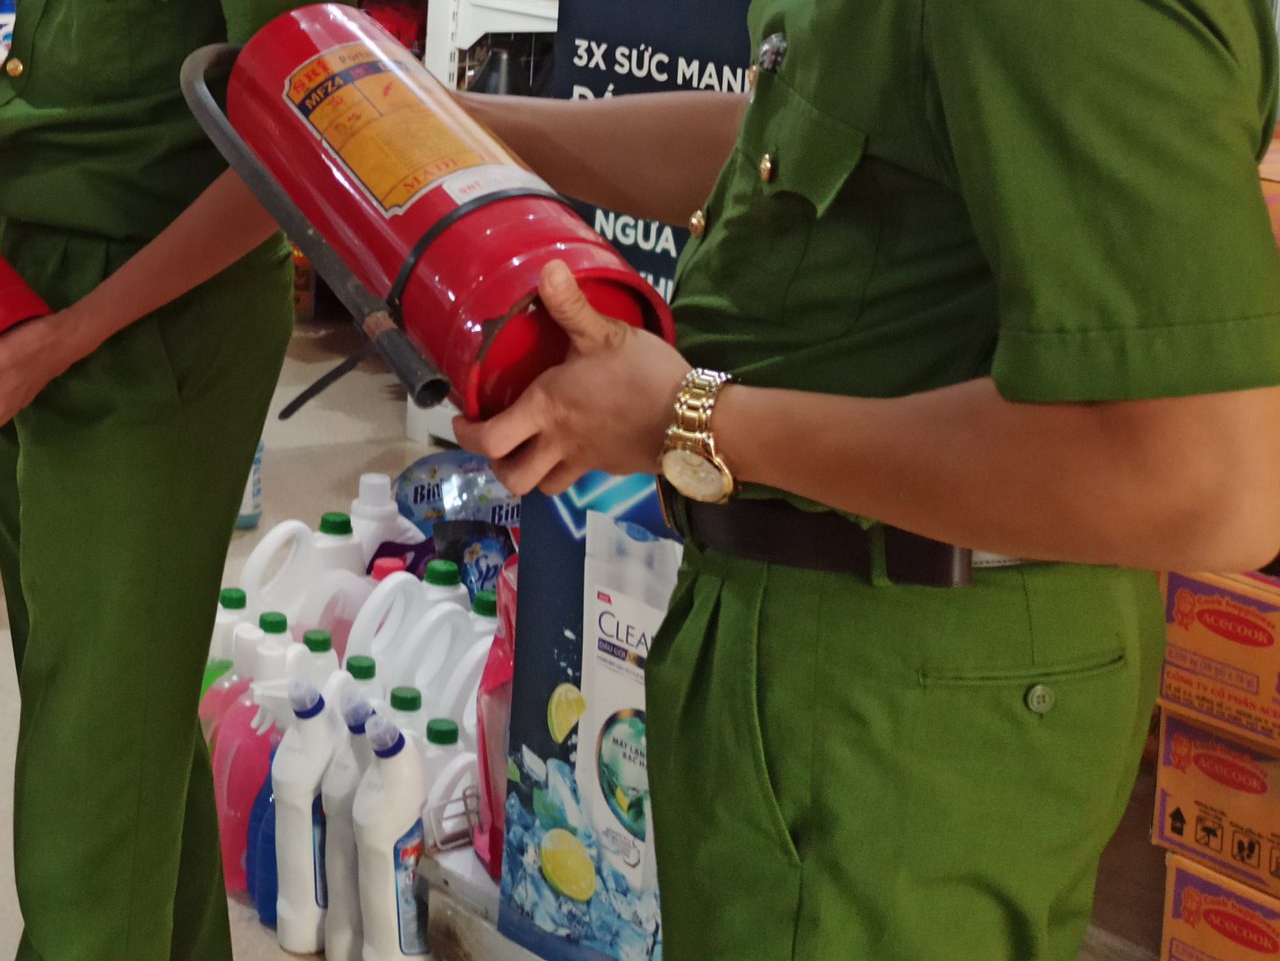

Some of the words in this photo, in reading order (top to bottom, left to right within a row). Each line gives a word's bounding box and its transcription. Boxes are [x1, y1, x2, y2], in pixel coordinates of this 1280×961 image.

[573, 38, 608, 71] 3X
[614, 42, 670, 83] SỨC
[598, 610, 655, 653] CLEA
